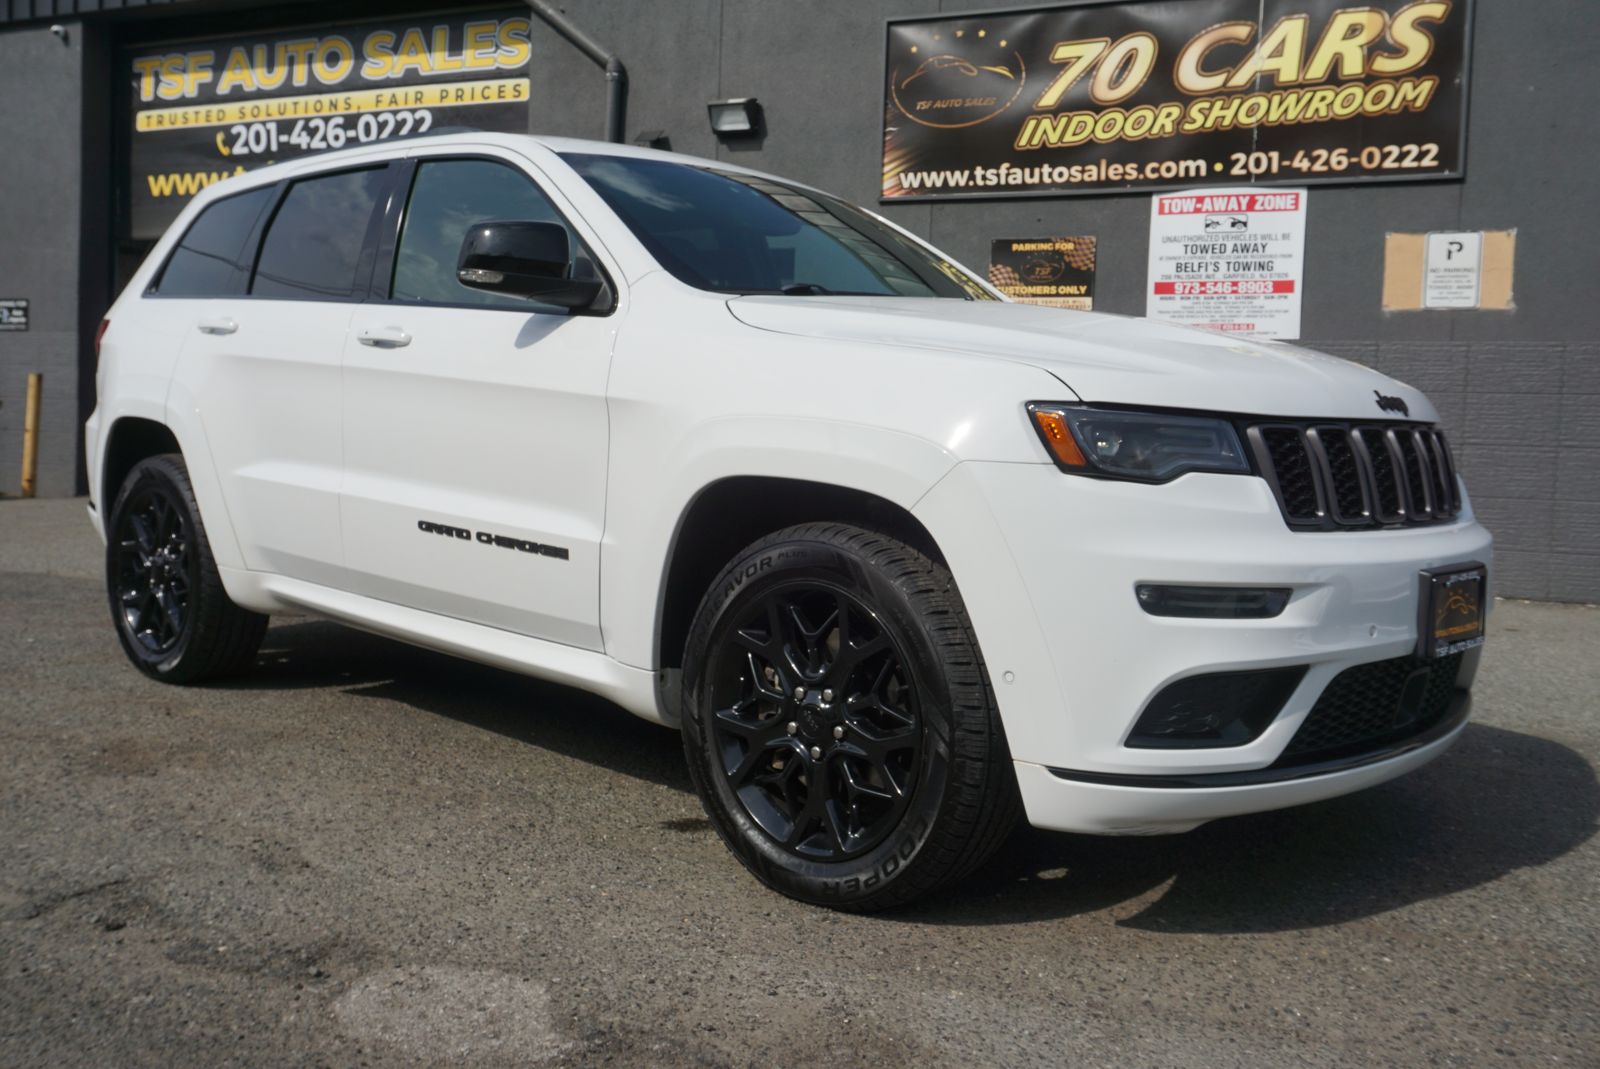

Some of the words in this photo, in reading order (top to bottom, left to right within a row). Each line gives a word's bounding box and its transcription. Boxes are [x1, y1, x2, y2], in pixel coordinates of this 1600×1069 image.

[133, 51, 215, 102] TSF
[216, 34, 355, 95] AUTO
[360, 17, 532, 81] SALES
[1034, 31, 1158, 111] 70
[1173, 0, 1453, 95] CARS
[145, 108, 226, 128] TRUSTED
[238, 96, 361, 120] SOLUTIONS,
[376, 91, 424, 107] FAIR
[439, 84, 522, 102] PRICES
[916, 100, 931, 111] TSF
[933, 98, 962, 109] AUTO
[964, 96, 997, 107] SALES
[1015, 105, 1183, 150] INDOOR
[1181, 76, 1439, 132] SHOWROOM
[230, 109, 433, 155] 201-426-0222
[899, 157, 1207, 189] www.tsfautosales.com
[1230, 143, 1439, 176] 201-426-0222
[1163, 196, 1250, 214] TOW-AWAY
[1254, 194, 1297, 211] ZONE
[1011, 242, 1053, 252] PARKING
[1055, 242, 1075, 251] FOR
[1162, 234, 1220, 244] UNAUTHORIZED
[1222, 234, 1258, 242] VEHICLES
[1183, 243, 1227, 255] TOWED
[1231, 242, 1268, 254] AWAY
[1175, 261, 1220, 273] BELFI'S
[1225, 260, 1274, 272] TOWING
[1058, 285, 1088, 294] ONLY
[1174, 281, 1274, 294] 973-546-8903
[418, 520, 471, 541] GRAND
[476, 531, 570, 561] CHEROKEE
